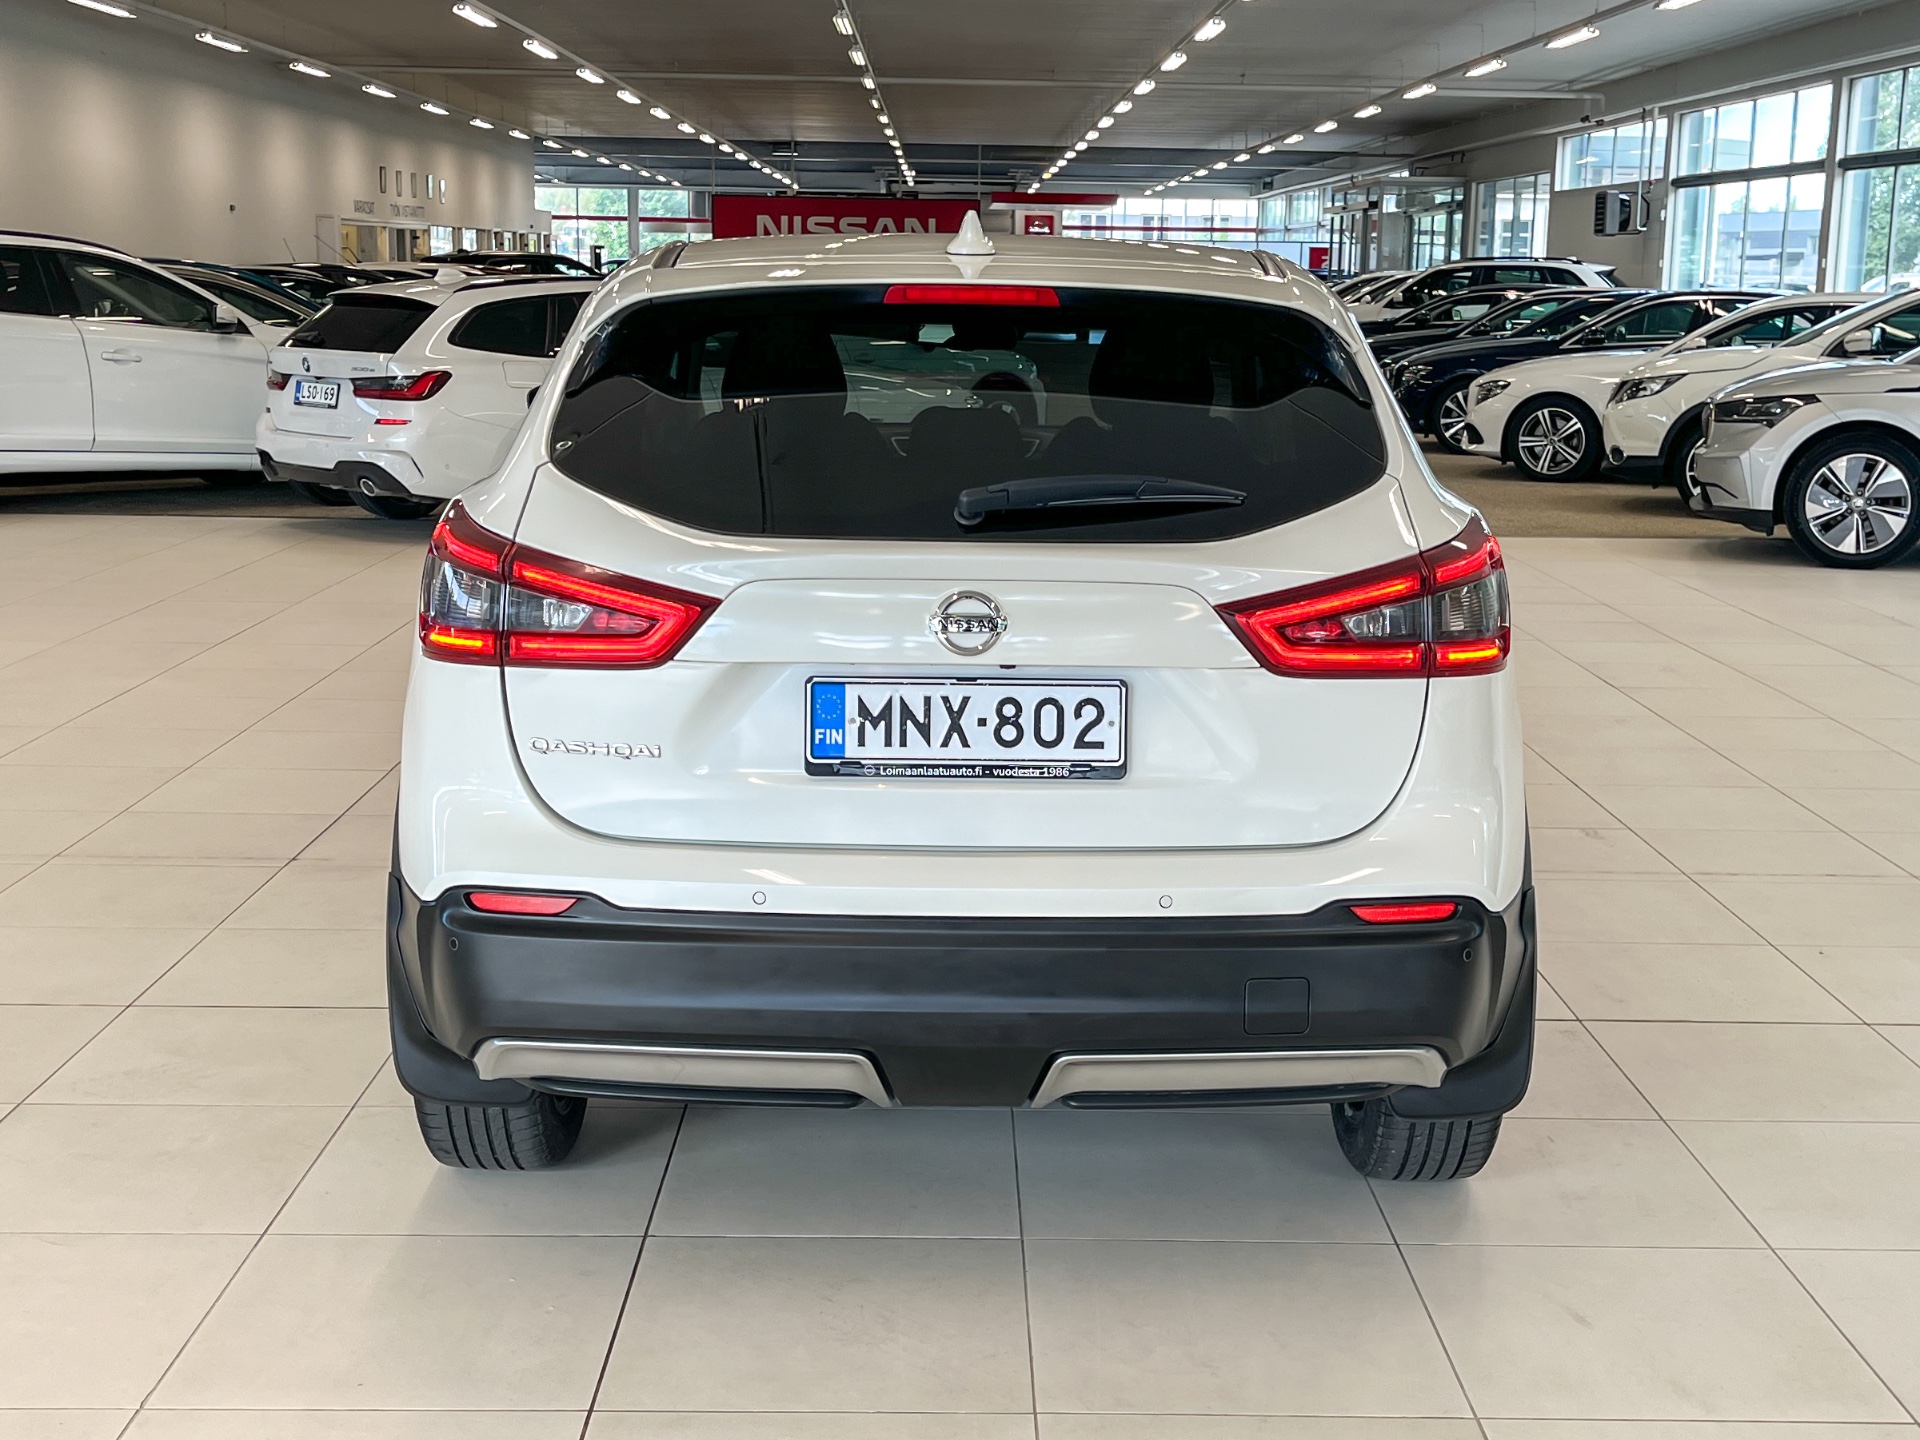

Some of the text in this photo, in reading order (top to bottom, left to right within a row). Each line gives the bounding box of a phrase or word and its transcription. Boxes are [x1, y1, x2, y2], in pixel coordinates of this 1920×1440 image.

[756, 214, 937, 236] NISSAN
[939, 617, 999, 632] NISSAN
[857, 694, 1105, 750] MNX-802
[814, 728, 843, 745] FIN
[529, 736, 662, 760] QASHQAI
[879, 765, 983, 777] Loimaanlaatuauto.fi
[992, 766, 1040, 777] vuodesta
[1043, 767, 1070, 777] 1986
